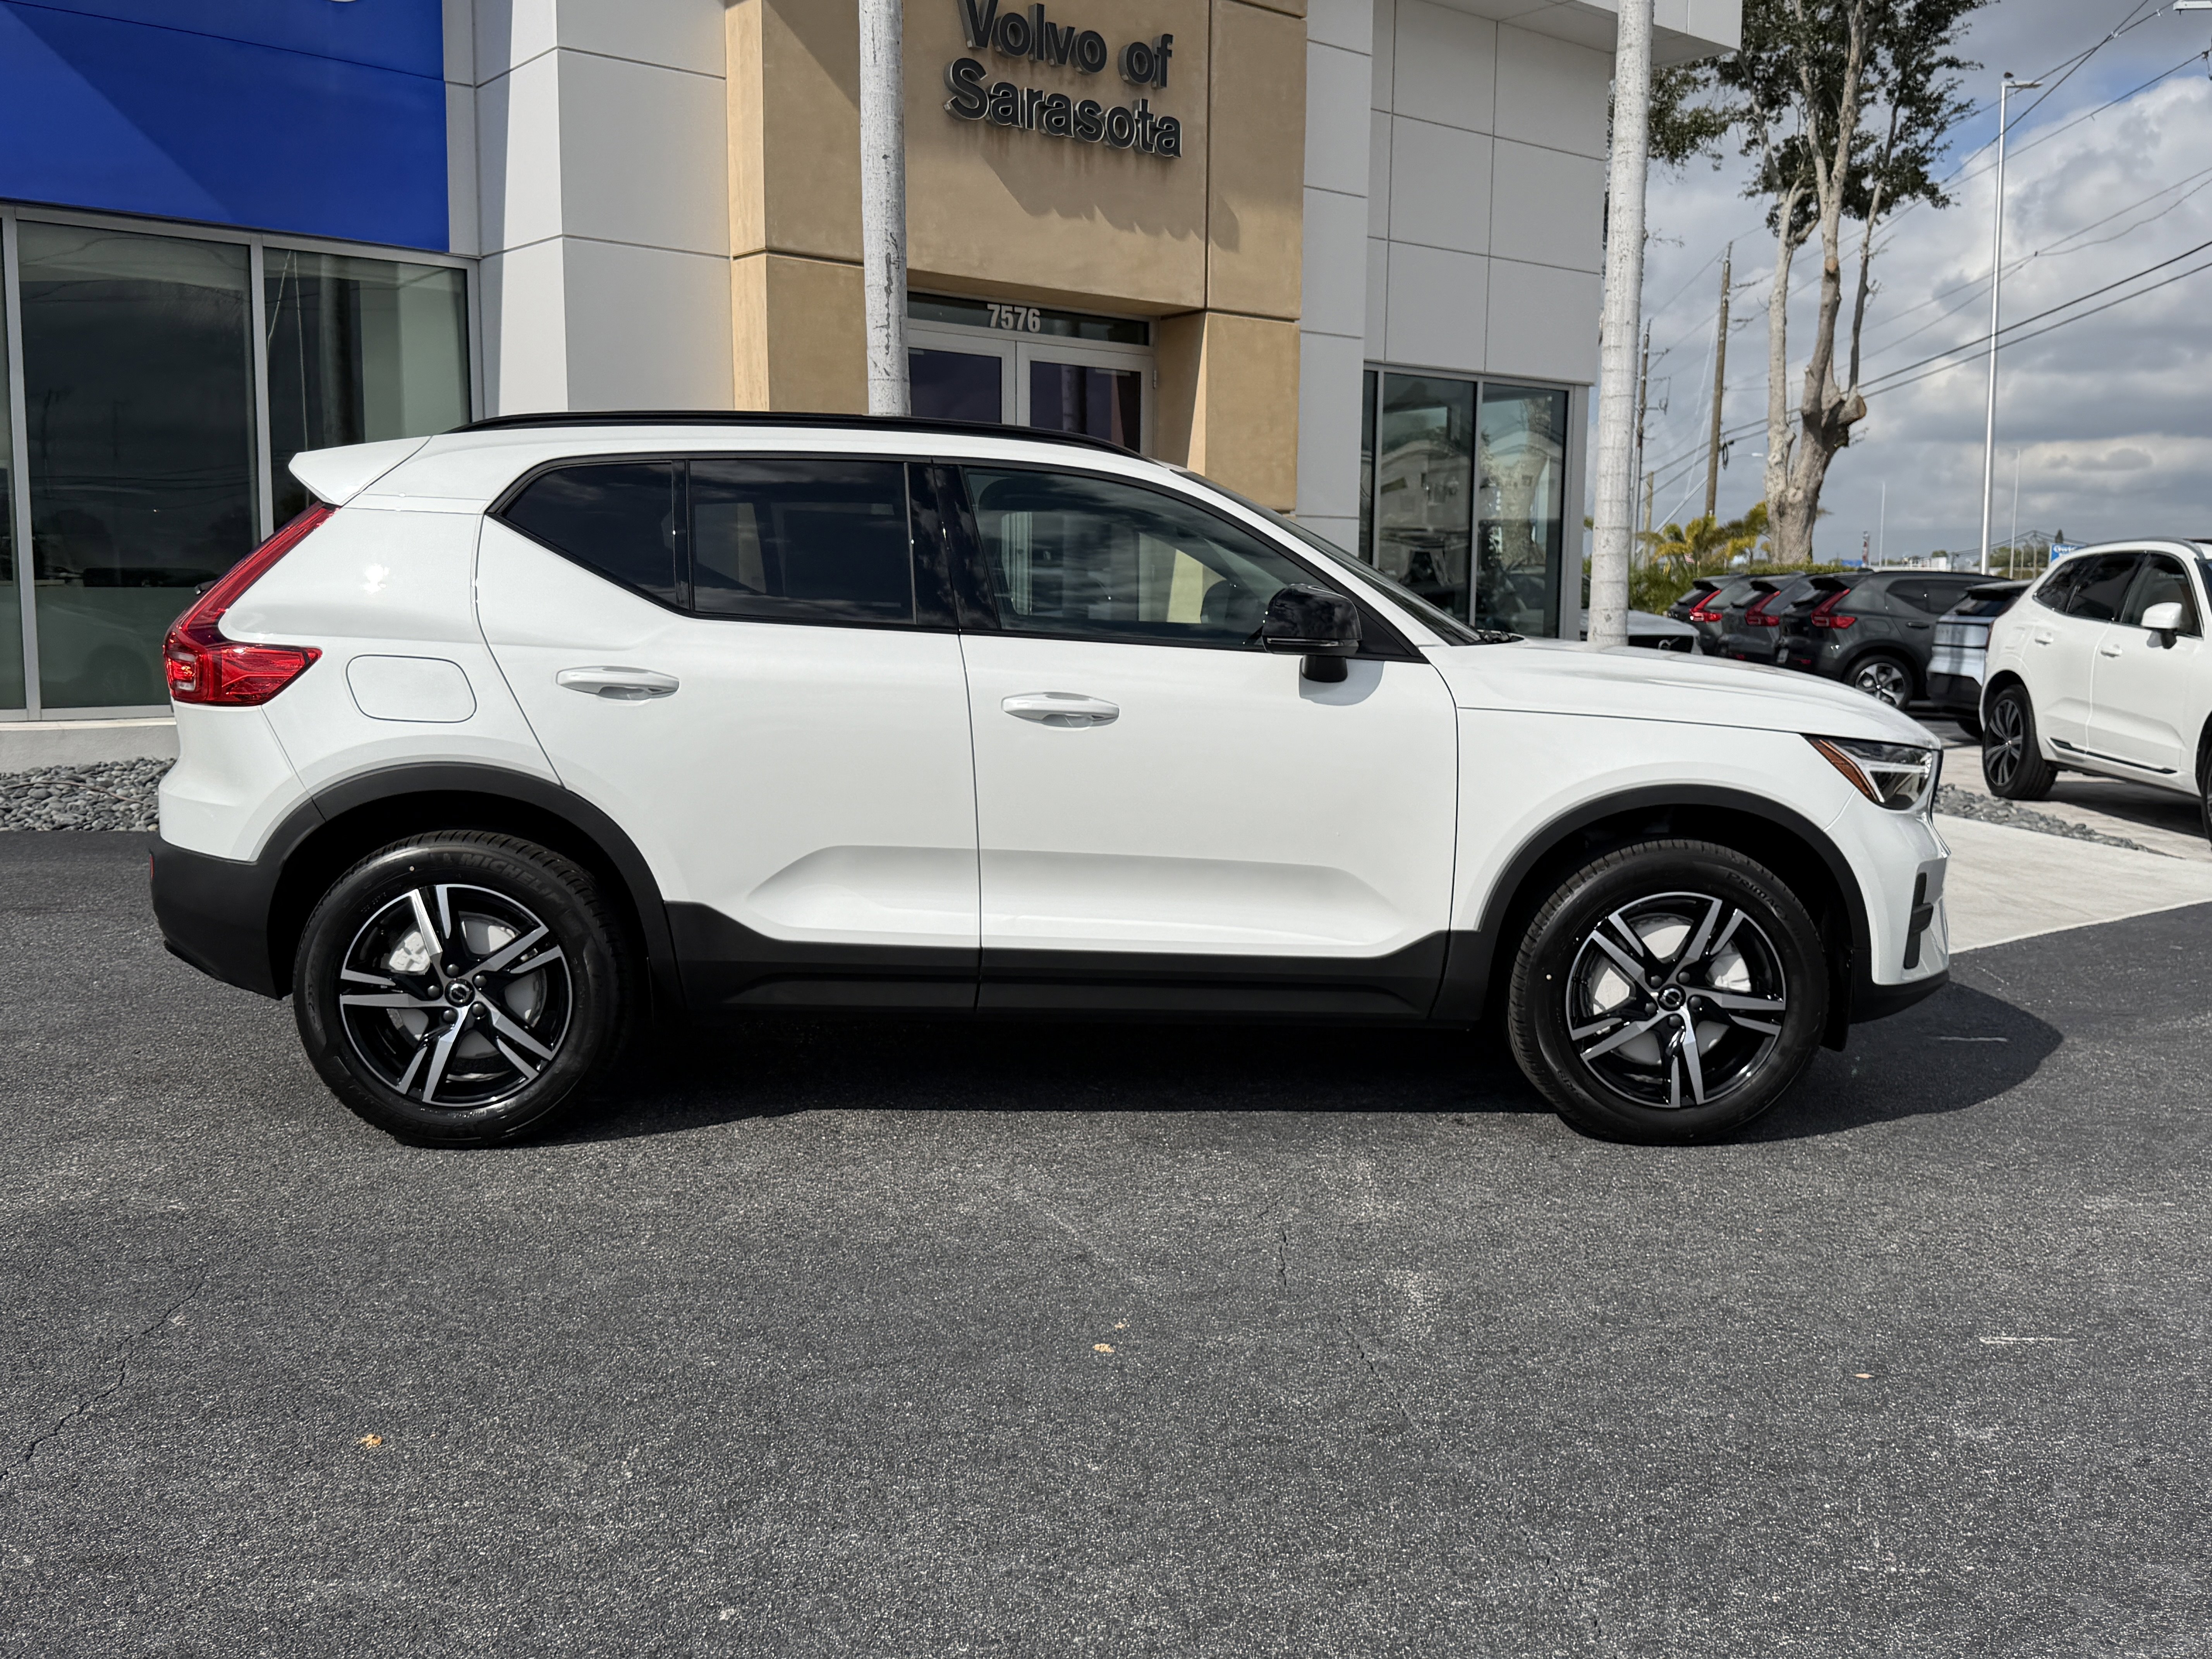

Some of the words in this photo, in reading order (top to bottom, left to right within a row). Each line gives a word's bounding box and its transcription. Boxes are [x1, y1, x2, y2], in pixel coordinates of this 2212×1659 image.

[957, 0, 1108, 75] Volvo
[1118, 33, 1174, 89] of
[943, 57, 1182, 158] Sarasota
[987, 303, 1041, 333] 7576
